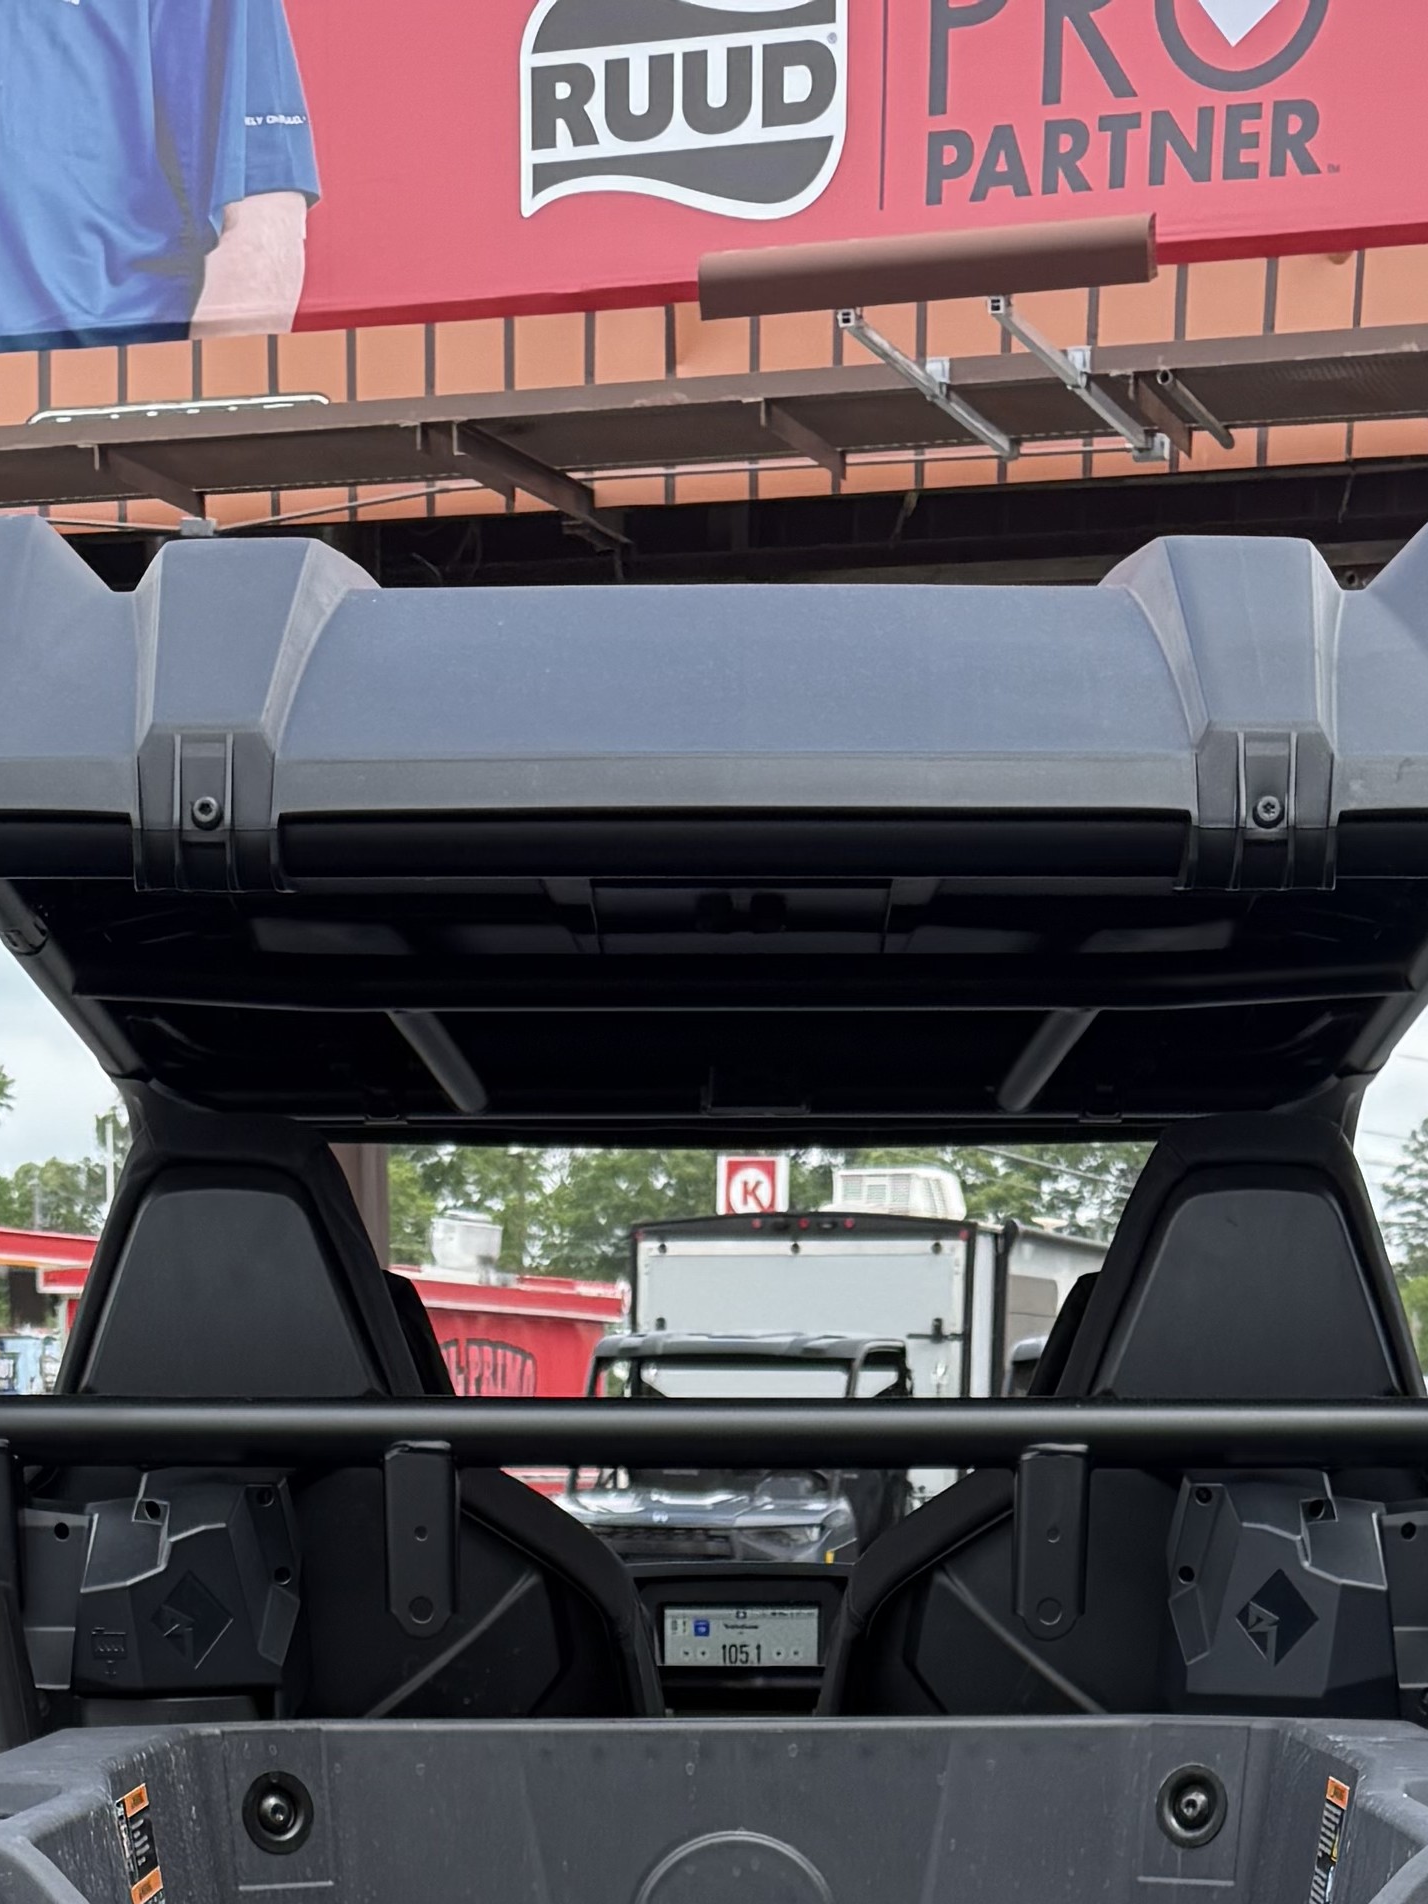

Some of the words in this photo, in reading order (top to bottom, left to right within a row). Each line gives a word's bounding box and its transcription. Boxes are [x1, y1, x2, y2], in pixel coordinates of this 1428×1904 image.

[530, 39, 837, 151] RUUD
[925, 98, 1323, 206] PARTNER
[721, 1643, 762, 1665] 105.1
